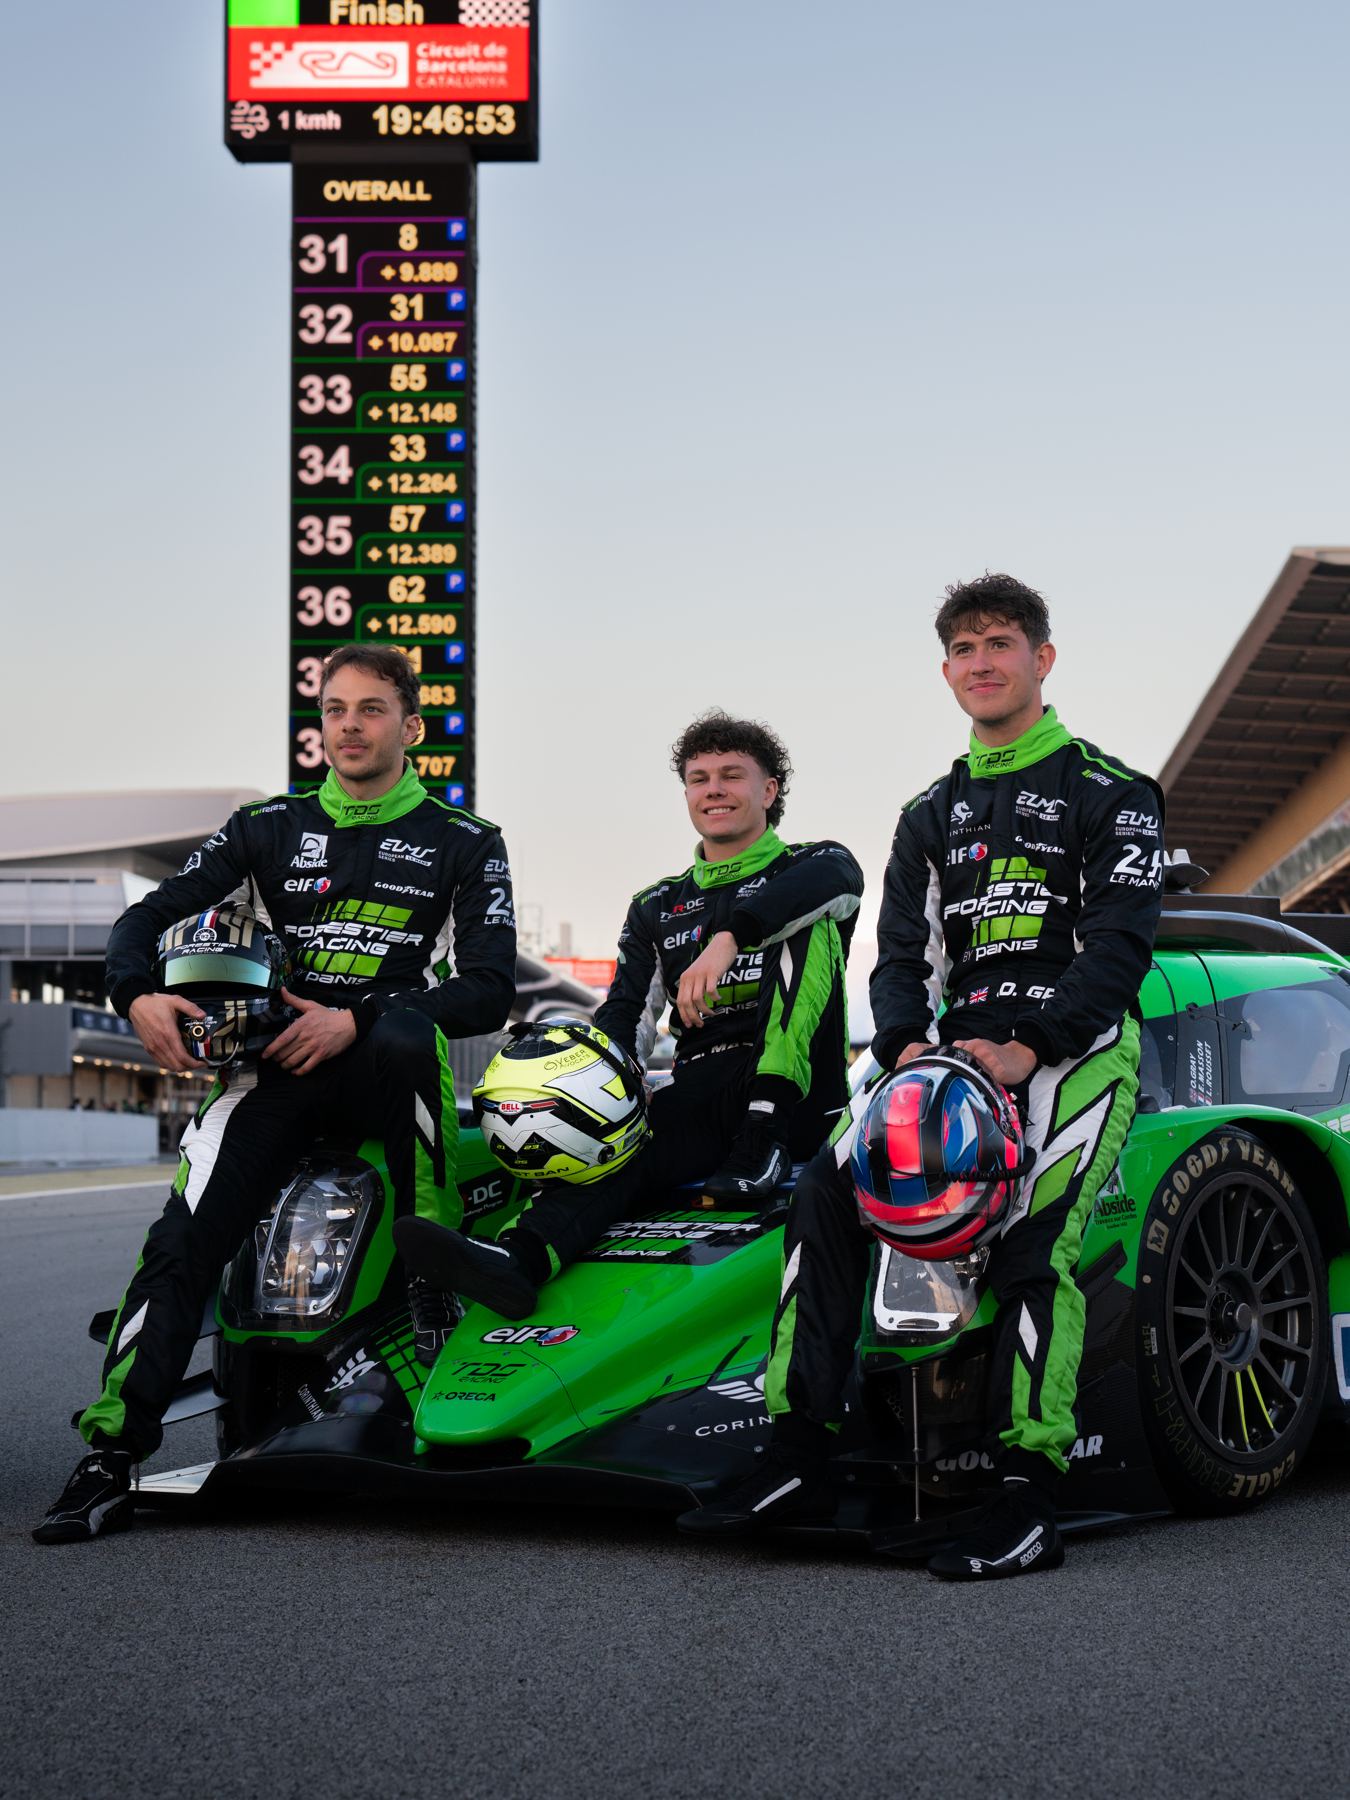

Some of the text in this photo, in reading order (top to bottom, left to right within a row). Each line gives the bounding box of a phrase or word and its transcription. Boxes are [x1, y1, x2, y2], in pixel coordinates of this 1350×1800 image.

[329, 0, 424, 25] Finish
[416, 42, 508, 58] Circuit de
[416, 58, 508, 73] Barcelona
[278, 110, 341, 130] 1 kmh
[372, 105, 516, 135] 19:46:53
[323, 181, 432, 201] OVERALL
[398, 224, 418, 251] 8
[299, 234, 348, 274] 31
[389, 294, 424, 321] 31
[299, 304, 353, 344] 32
[389, 364, 427, 391] 55
[298, 374, 353, 414] 33
[389, 434, 427, 462] 33
[297, 445, 353, 485] 34
[389, 505, 426, 532] 57
[297, 515, 353, 555] 35
[388, 575, 426, 603] 62
[296, 586, 352, 626] 36
[296, 657, 322, 697] 3
[949, 824, 991, 838] INTHIAN
[284, 878, 314, 893] elf
[374, 881, 435, 898] GOODYEAR
[1109, 874, 1128, 883] LE
[484, 916, 501, 925] LE
[664, 930, 690, 950] elf
[501, 1103, 520, 1111] BELL
[1162, 1137, 1296, 1216] GOODYEAR
[608, 1222, 761, 1231] ORESTIER
[483, 1326, 549, 1344] elf
[445, 1391, 496, 1402] ORECA
[695, 1414, 775, 1436] CORIN
